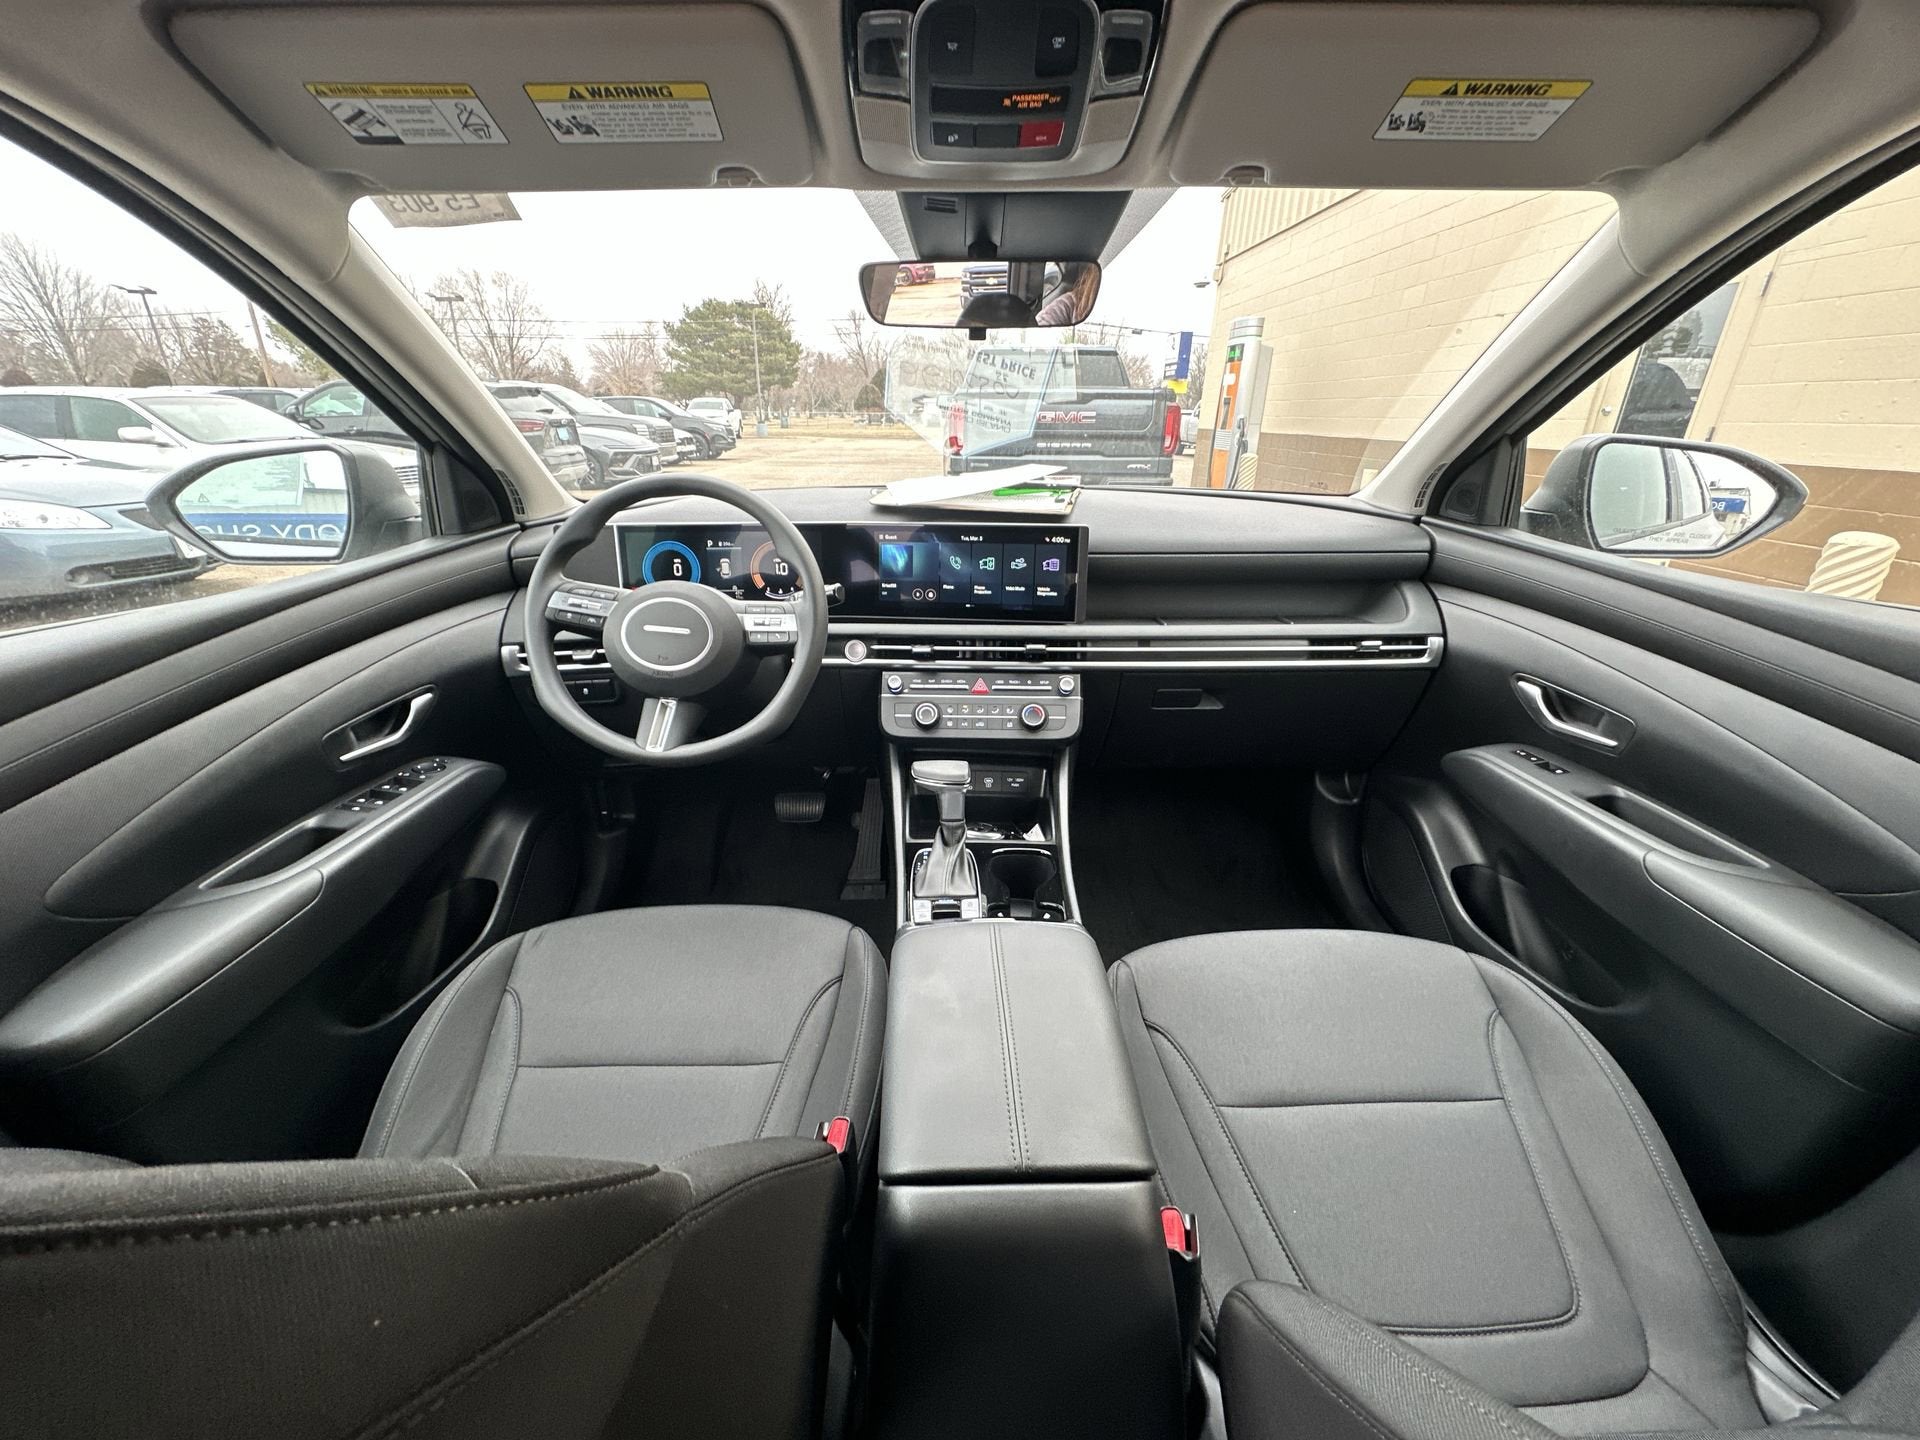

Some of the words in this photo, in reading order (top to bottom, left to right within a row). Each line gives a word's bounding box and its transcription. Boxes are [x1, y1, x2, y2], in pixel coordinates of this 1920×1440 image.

[585, 85, 674, 99] WARNING
[1463, 82, 1552, 96] WARNING
[1012, 93, 1049, 102] PASSENGER
[1050, 96, 1061, 104] OFF
[1037, 411, 1097, 424] GMC
[707, 539, 713, 548] P
[673, 563, 682, 577] 0
